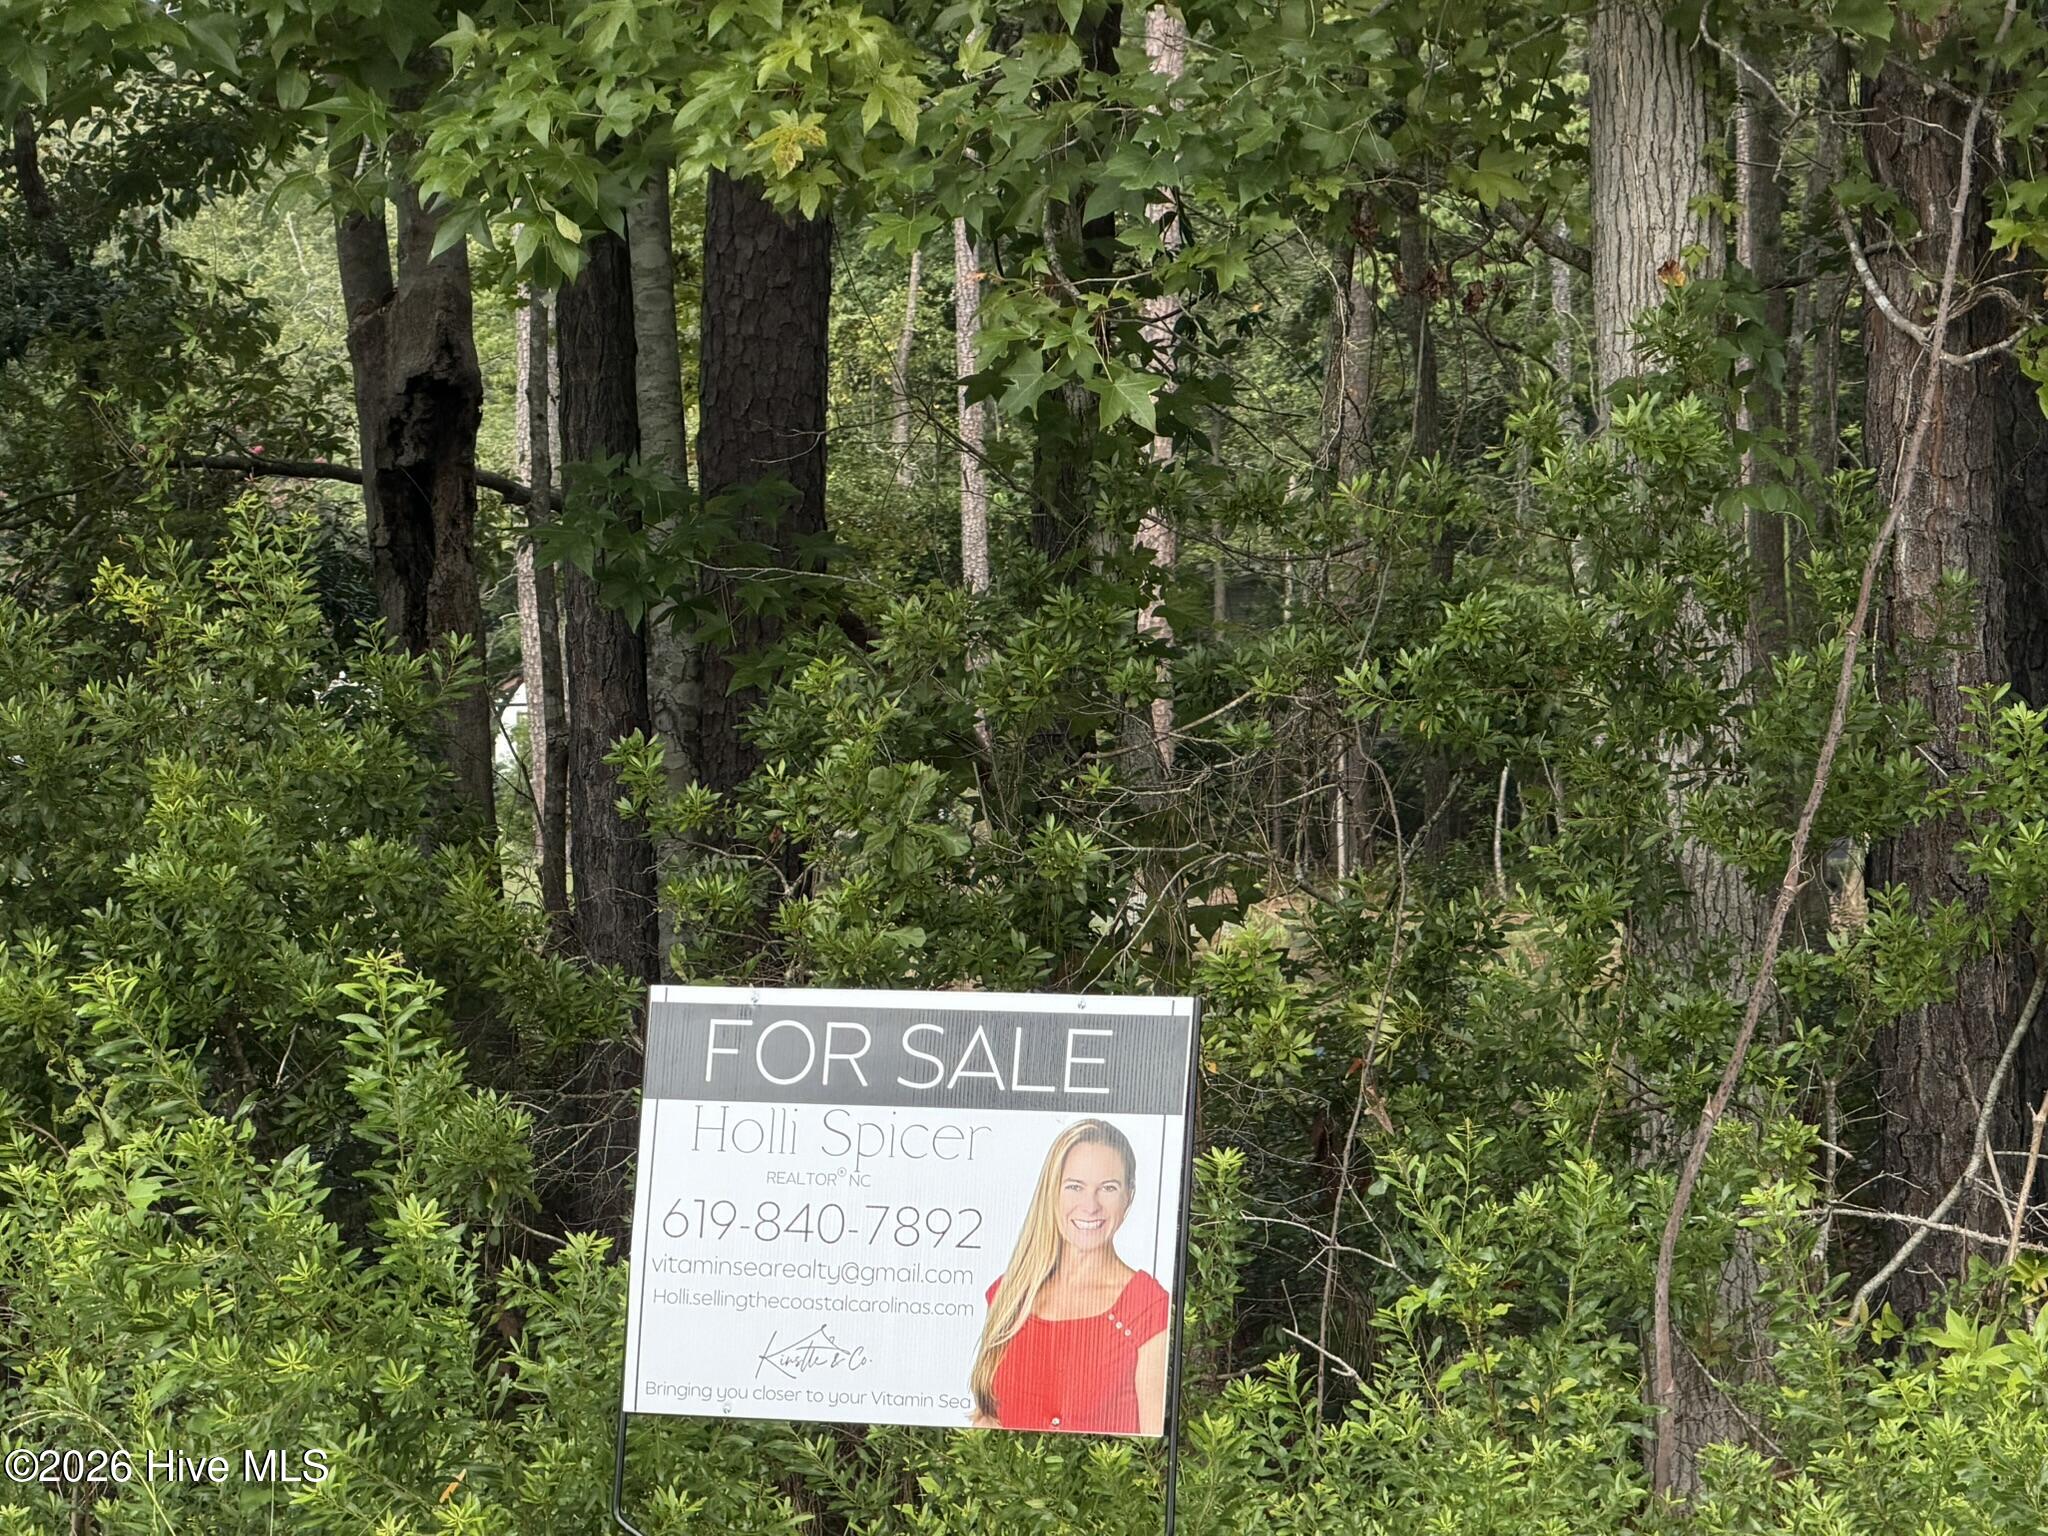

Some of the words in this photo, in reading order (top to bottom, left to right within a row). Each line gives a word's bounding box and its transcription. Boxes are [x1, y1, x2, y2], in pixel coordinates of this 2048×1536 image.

[705, 1018, 872, 1087] FOR
[897, 1023, 1113, 1094] SALE
[692, 1105, 800, 1154] Holli
[821, 1109, 992, 1172] Spicer
[849, 1174, 872, 1188] NC
[662, 1198, 983, 1249] 619-840-7892
[651, 1254, 974, 1286] vitaminsearealty@gmail.com
[653, 1288, 975, 1317] Holli.sellingthecoastalcarolinas.com
[645, 1381, 712, 1401] Bringing
[717, 1387, 749, 1400] you
[752, 1385, 802, 1401] closer
[806, 1389, 824, 1402] to
[828, 1391, 867, 1407] your
[871, 1391, 933, 1408] Vitamin
[938, 1393, 971, 1408] Sea
